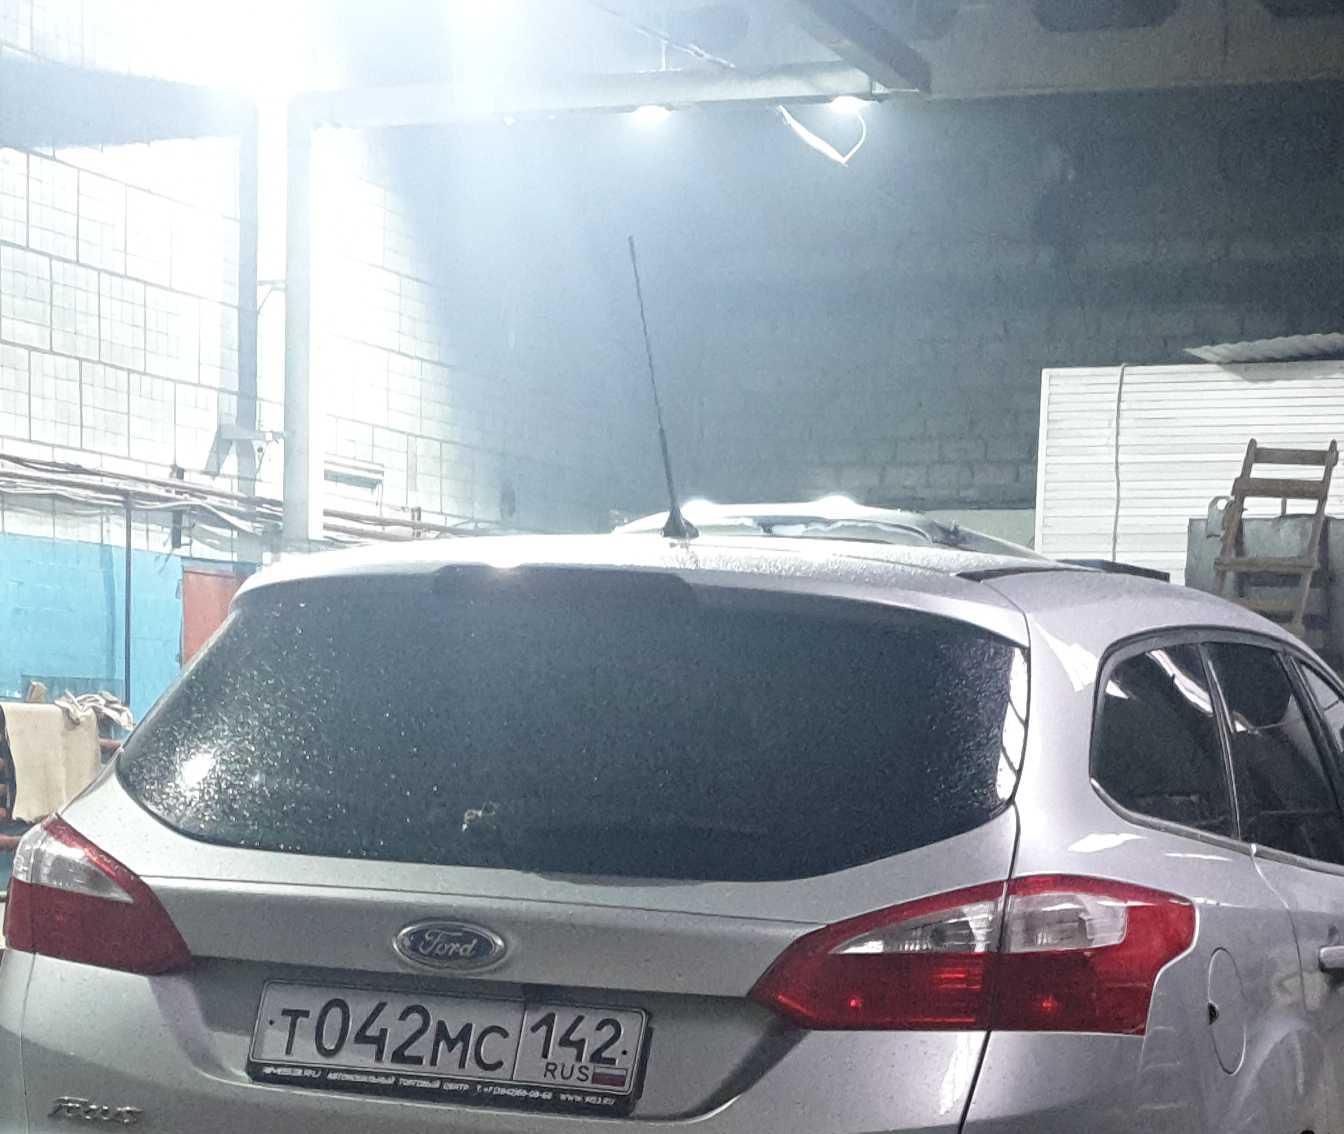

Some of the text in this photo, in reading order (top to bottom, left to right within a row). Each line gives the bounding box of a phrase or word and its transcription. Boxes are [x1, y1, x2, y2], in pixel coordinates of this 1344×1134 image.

[419, 929, 478, 957] Ford
[280, 997, 621, 1071] Т042МС 142
[544, 1063, 590, 1082] RUS
